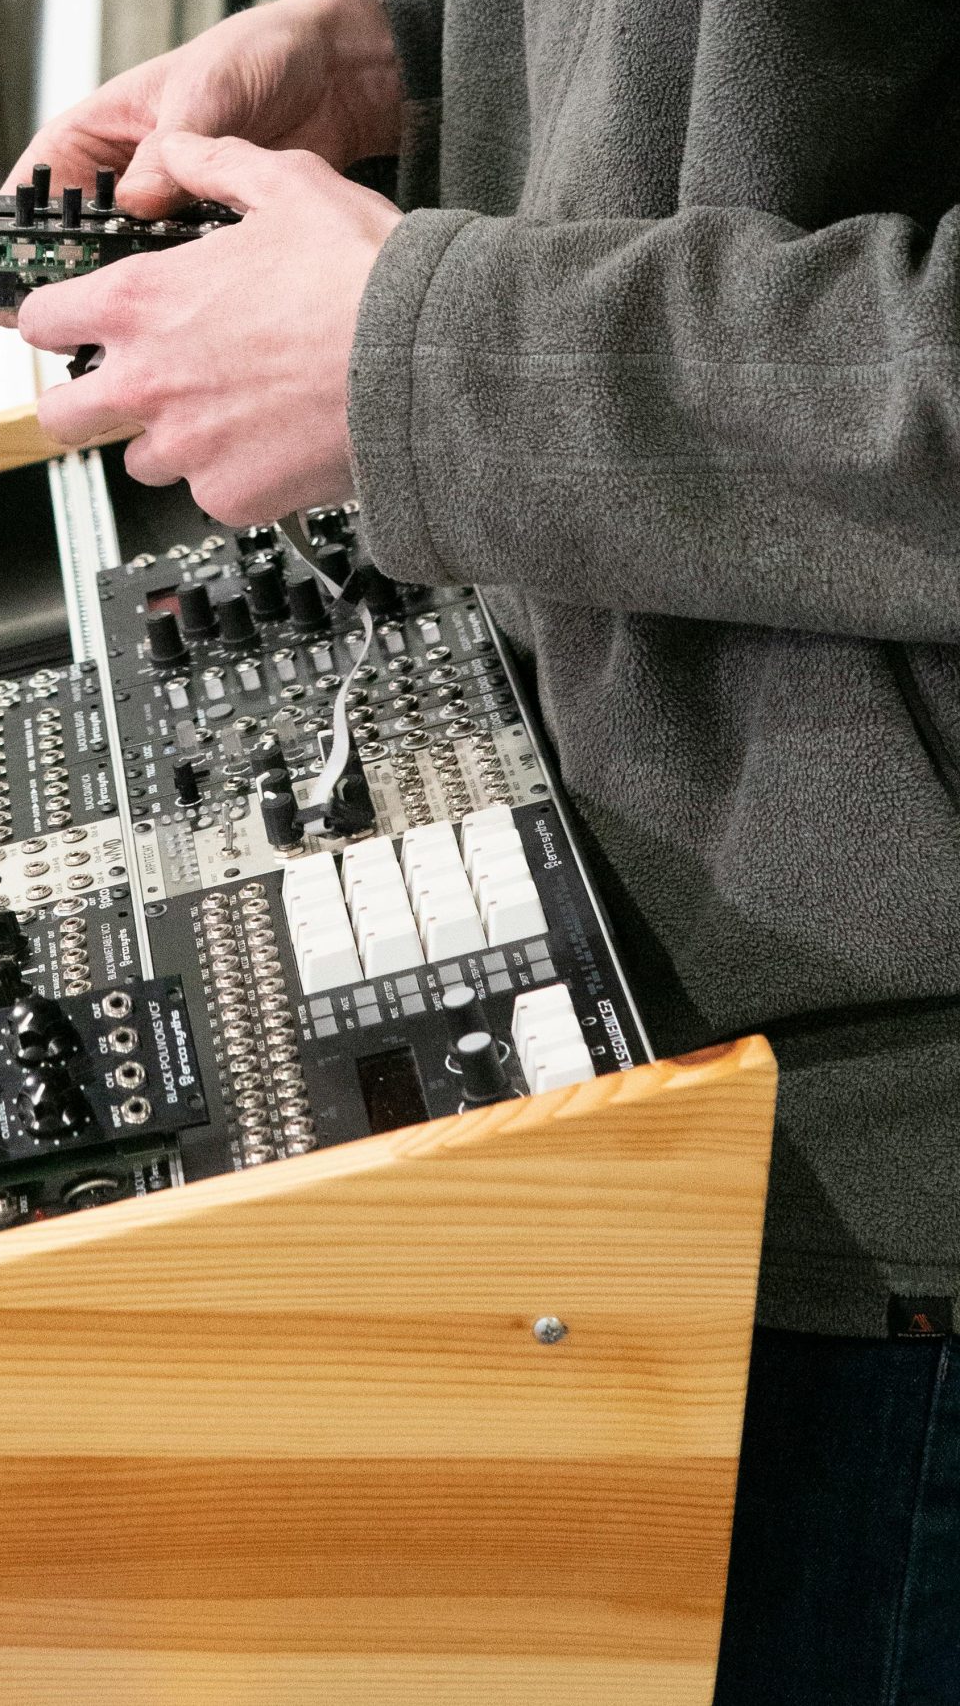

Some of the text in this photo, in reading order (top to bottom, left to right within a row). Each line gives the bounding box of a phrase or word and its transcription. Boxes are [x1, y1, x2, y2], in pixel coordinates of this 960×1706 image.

[102, 837, 122, 863] WMD
[530, 818, 558, 861] erica synths
[100, 922, 116, 980] BLACK WAVETABLE VCO
[91, 1001, 101, 1019] OUT
[98, 1035, 108, 1054] CV2
[169, 1009, 190, 1075] erica synths
[596, 998, 631, 1060] SEQUENCER
[148, 999, 178, 1103] BLACK POLIVOKS VCF
[104, 1071, 114, 1088] CV1
[110, 1103, 121, 1127] INPUT
